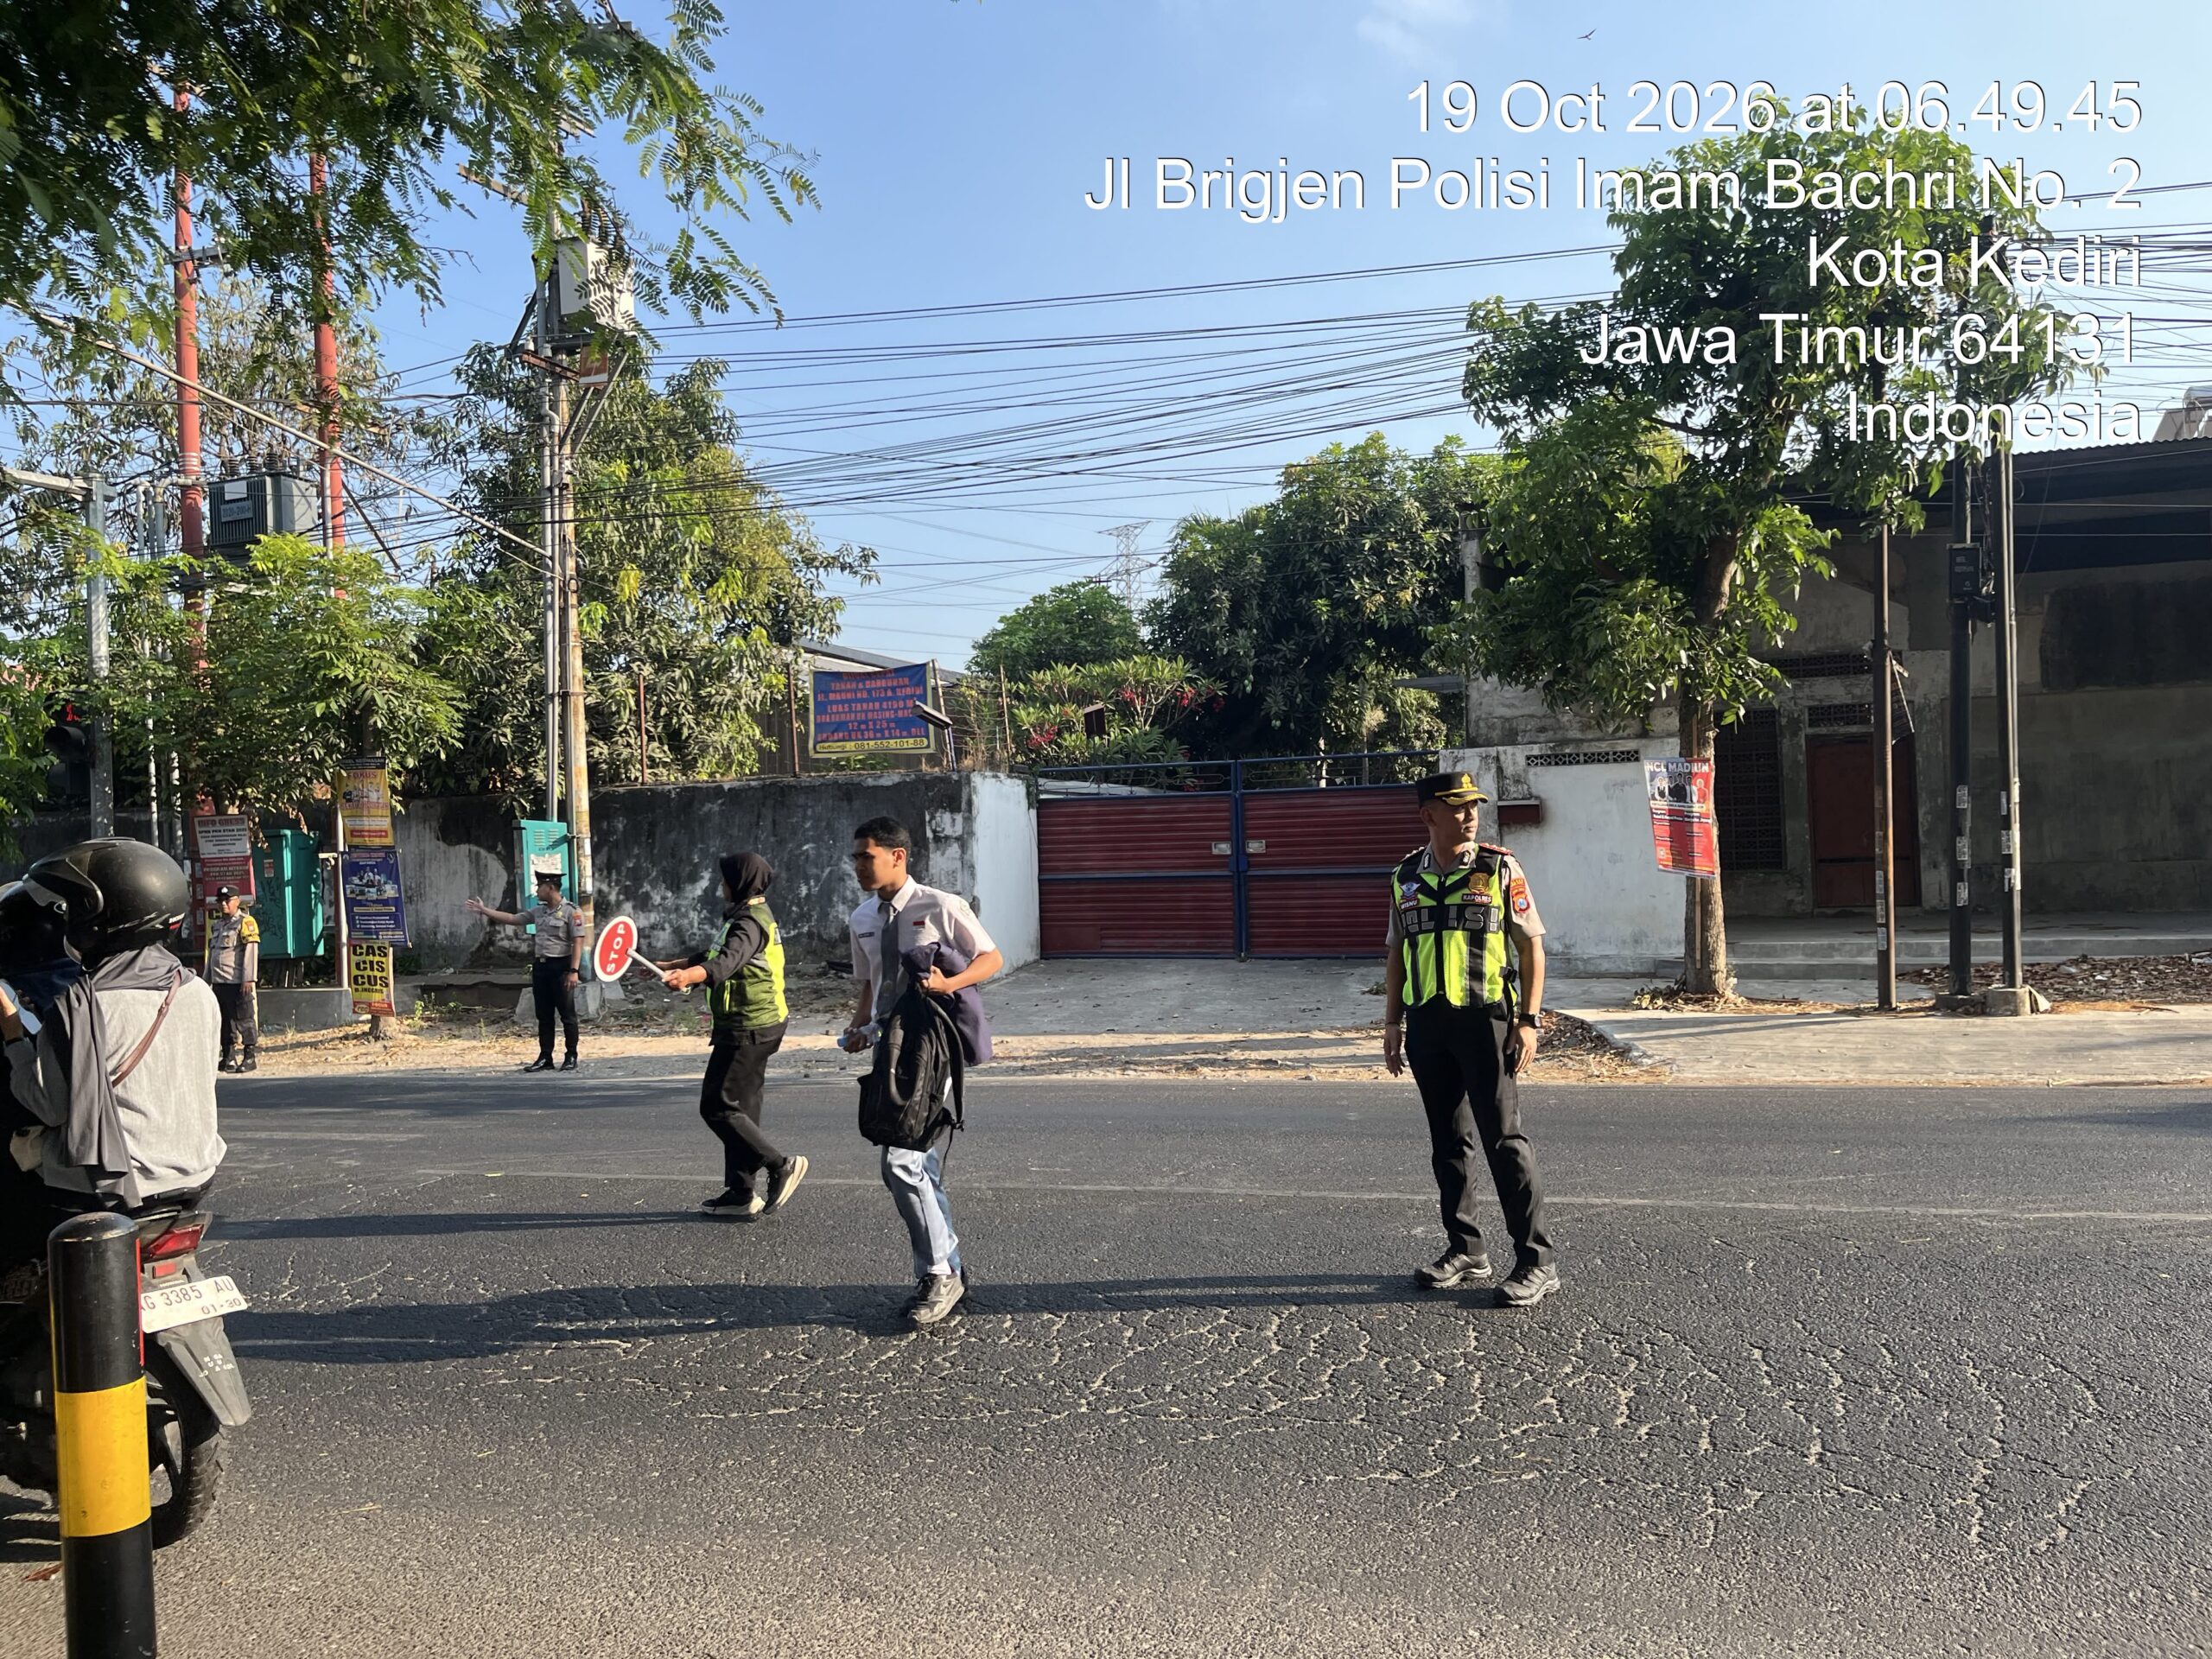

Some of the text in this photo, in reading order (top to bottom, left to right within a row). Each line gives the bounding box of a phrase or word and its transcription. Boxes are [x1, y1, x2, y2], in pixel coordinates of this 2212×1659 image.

[854, 739, 925, 750] 081-552-101-88
[1645, 761, 1709, 773] NCL MADIUN
[353, 944, 387, 957] CAS
[606, 924, 626, 973] STOP
[355, 960, 385, 973] CIS
[353, 975, 389, 988] CUS
[161, 1285, 202, 1306] 3385
[213, 1278, 234, 1294] AU
